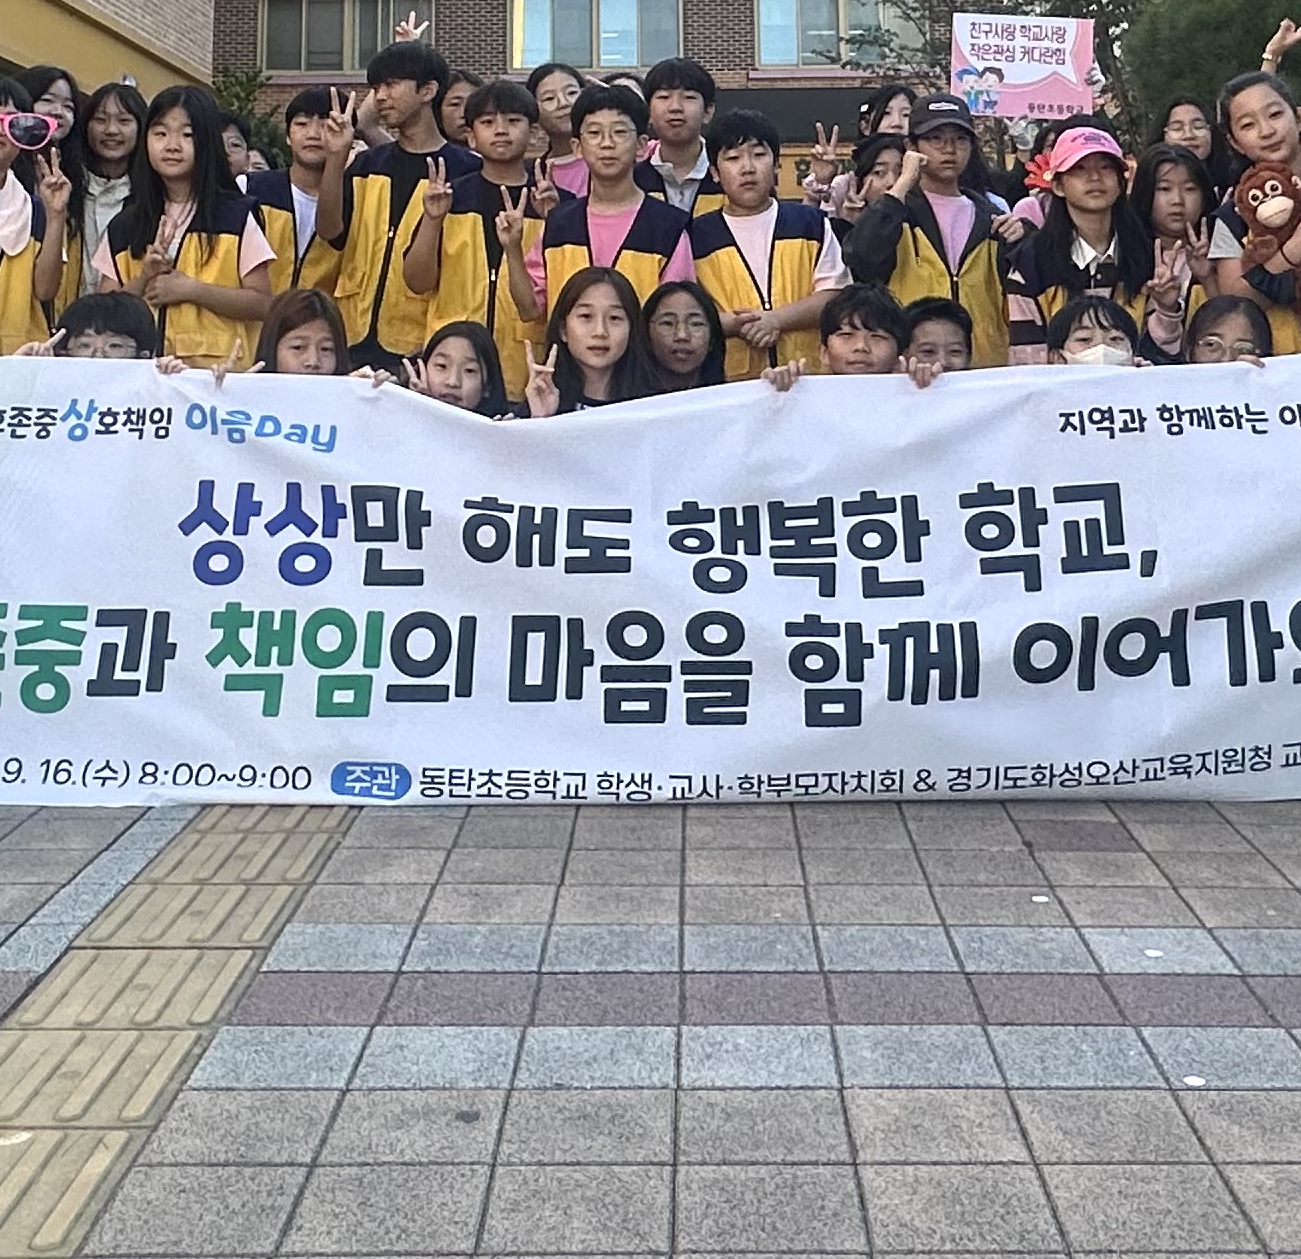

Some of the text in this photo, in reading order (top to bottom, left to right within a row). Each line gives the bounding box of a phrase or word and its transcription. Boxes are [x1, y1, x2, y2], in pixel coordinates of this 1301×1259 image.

[969, 21, 1067, 43] 친구사랑 학교사랑
[969, 42, 1066, 65] 작은관심 커다란힘
[1058, 405, 1148, 440] 지역과
[1155, 402, 1270, 436] 함께하는
[178, 478, 1159, 599] 상상만 해도 행복한 학교,
[204, 601, 476, 719] 책임의
[507, 609, 753, 726] 마음을
[783, 612, 981, 728] 함께
[138, 760, 312, 791] 8:00~9:00
[345, 765, 400, 797] 주관
[419, 766, 588, 801] 동탄초등학교
[912, 768, 937, 793] &
[946, 743, 1273, 793] 경기도화성오산교육지원청
